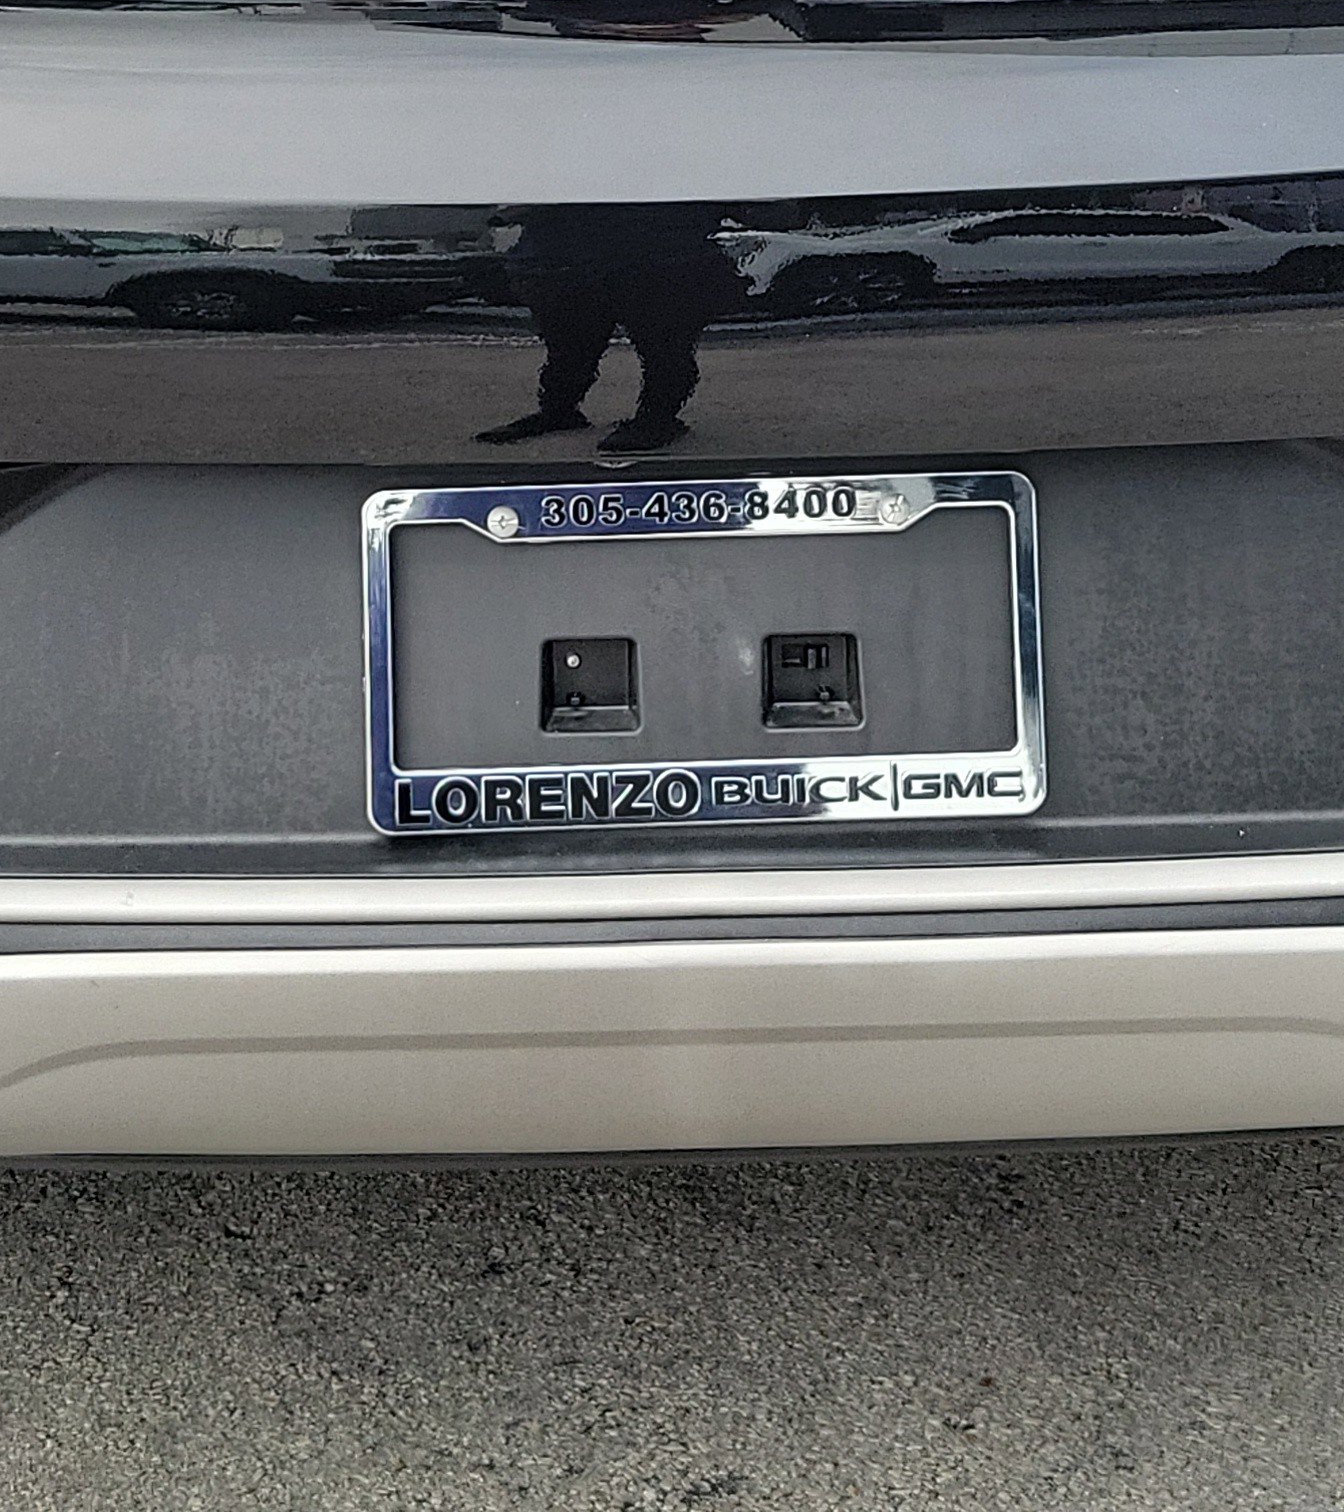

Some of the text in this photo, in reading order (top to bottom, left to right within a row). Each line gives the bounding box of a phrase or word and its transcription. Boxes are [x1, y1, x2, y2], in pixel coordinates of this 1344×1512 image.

[541, 486, 857, 528] 305-436-8400
[394, 767, 1024, 826] LORENZO BUICK GMC
